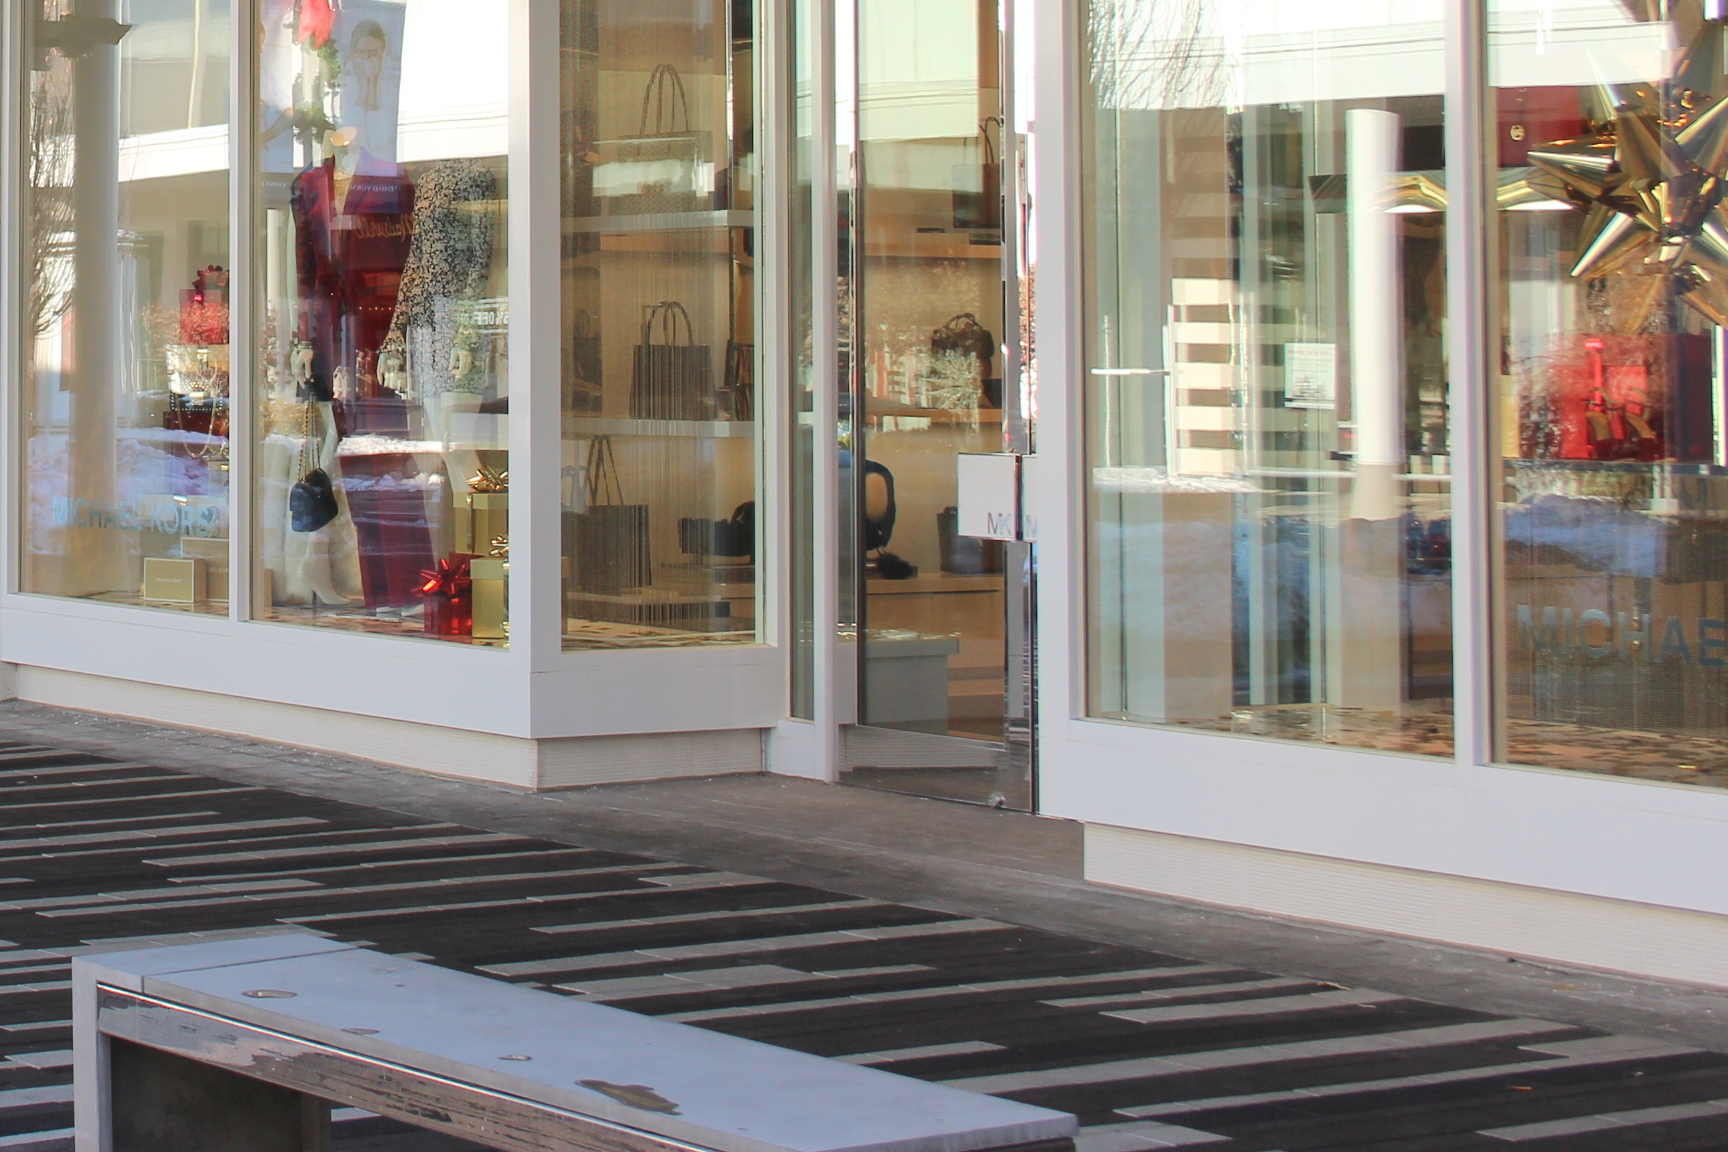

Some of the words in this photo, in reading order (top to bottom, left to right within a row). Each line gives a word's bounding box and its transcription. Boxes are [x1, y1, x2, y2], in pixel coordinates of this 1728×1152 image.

[52, 496, 142, 530] MICHAEL
[150, 502, 211, 537] KORS
[1517, 604, 1727, 667] MICHAE
